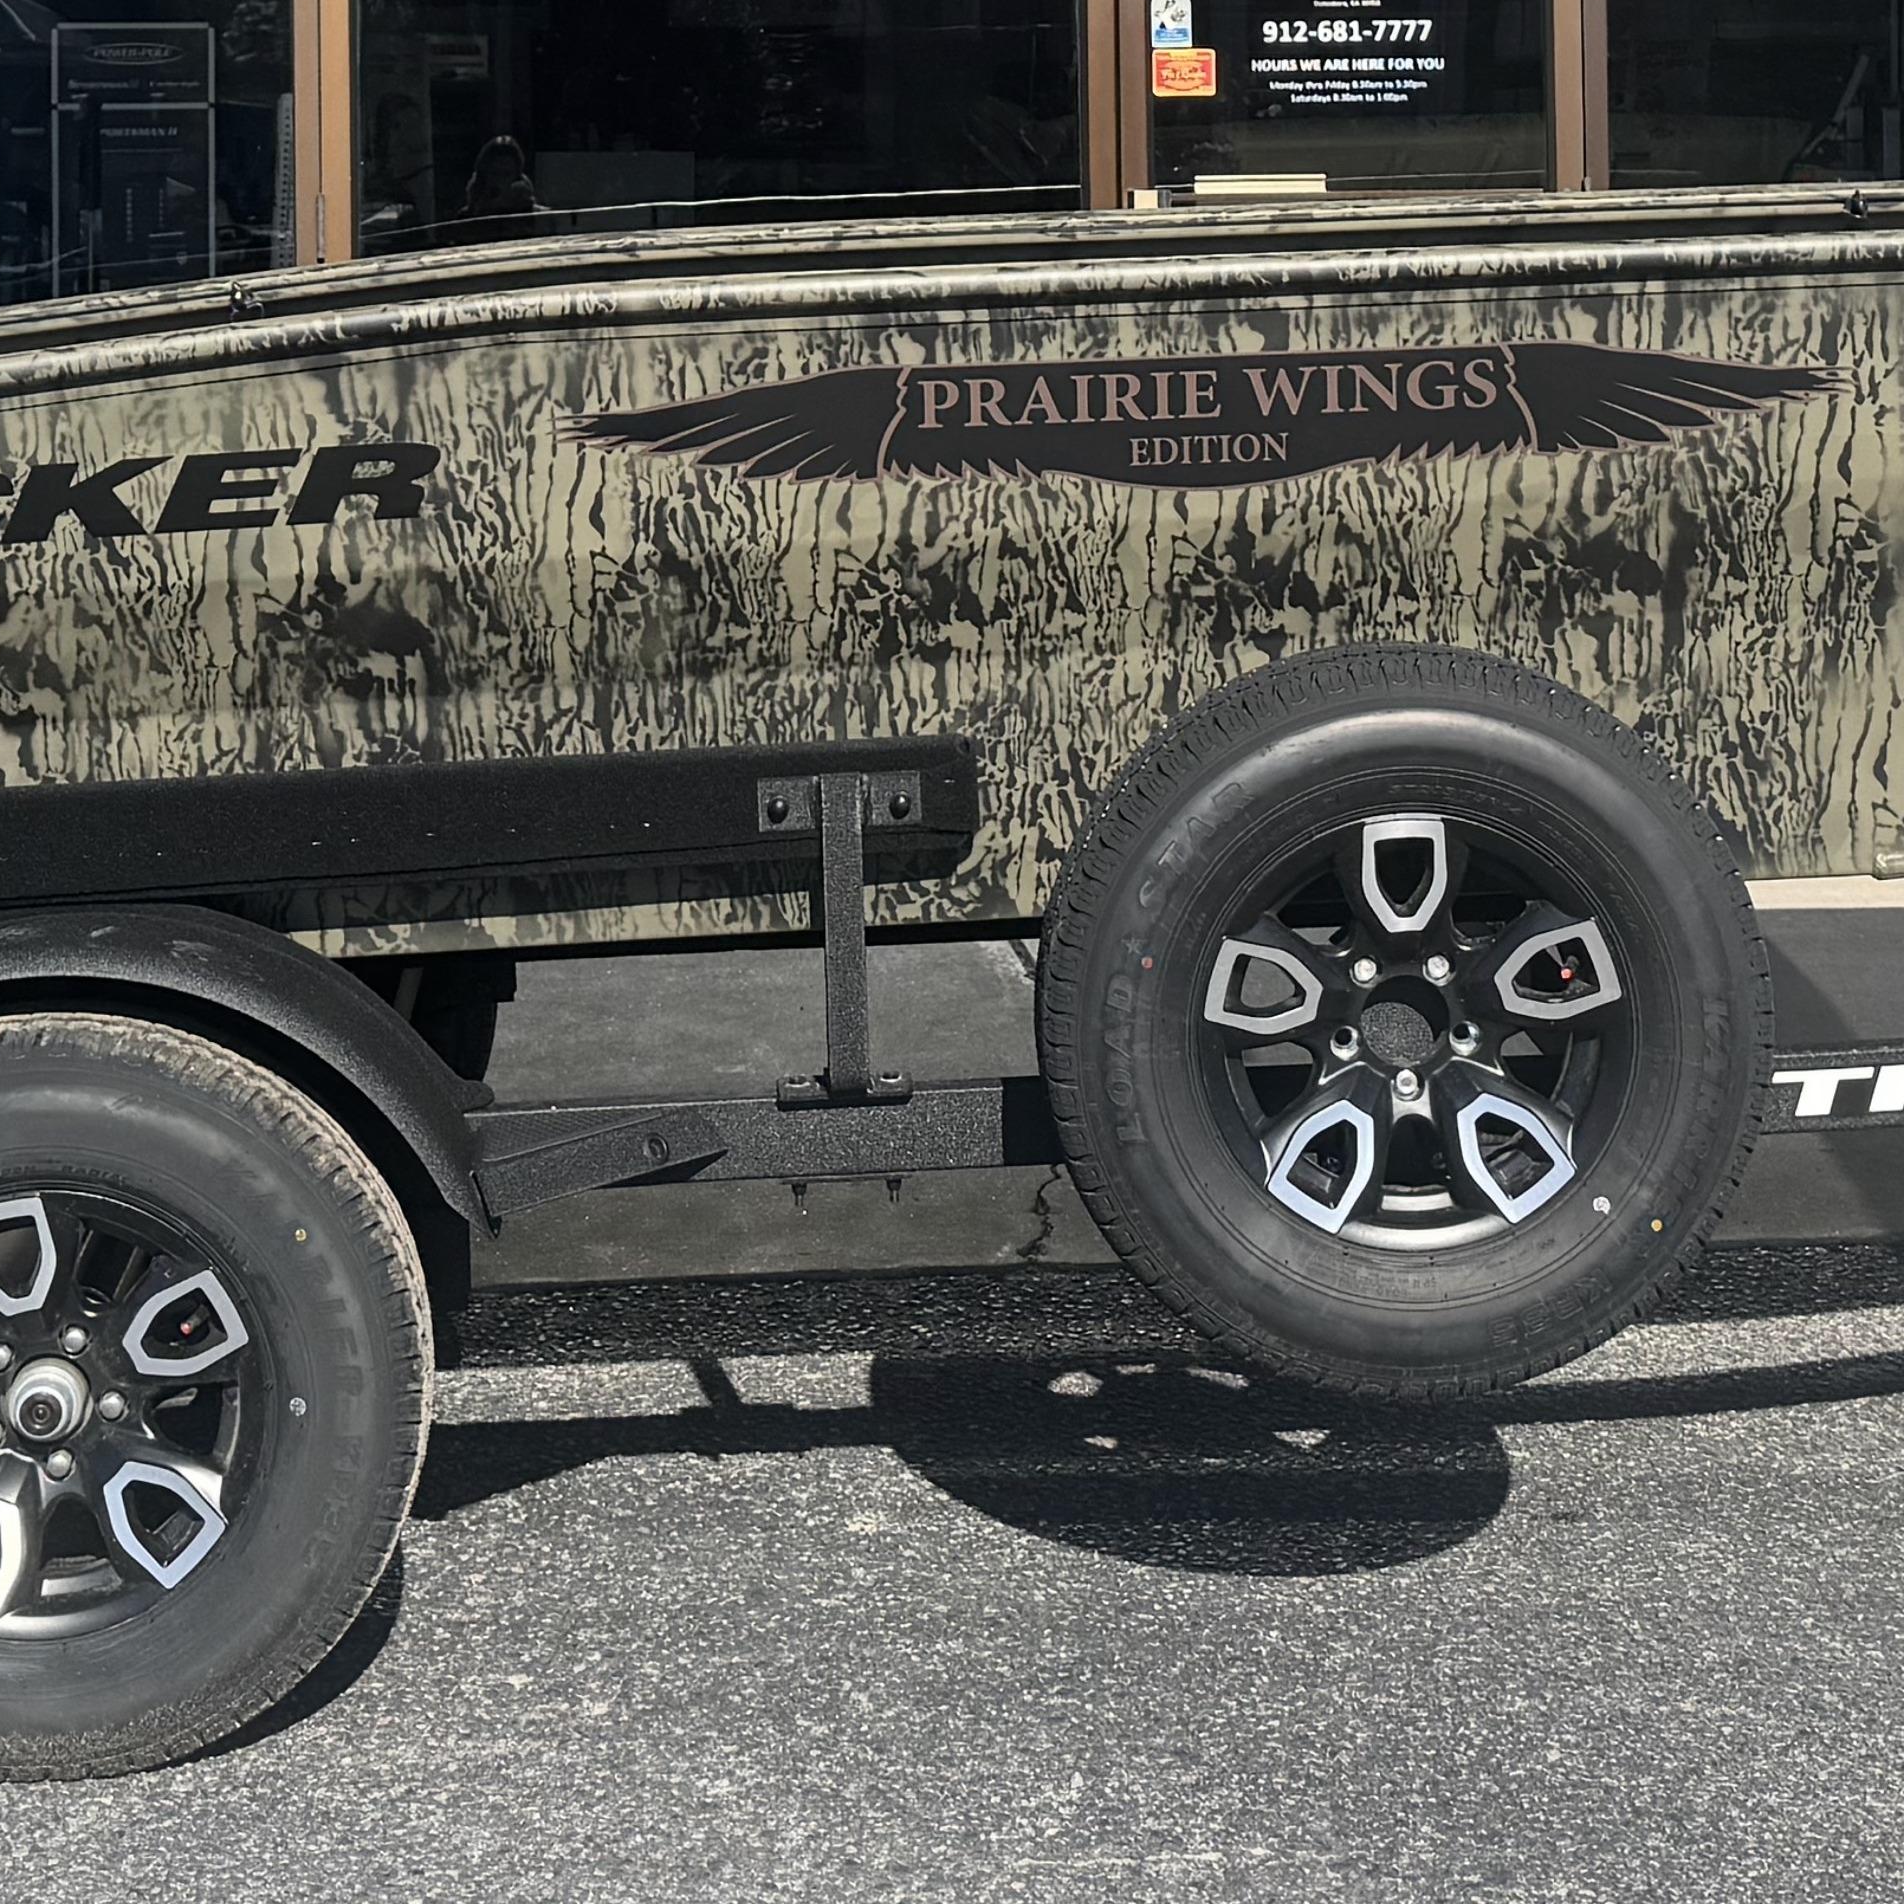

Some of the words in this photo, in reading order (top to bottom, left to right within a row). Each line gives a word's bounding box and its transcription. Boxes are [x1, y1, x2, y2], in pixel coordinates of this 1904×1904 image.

[1263, 19, 1433, 43] 912-681-7777
[1251, 59, 1298, 72] HOURS
[1300, 59, 1321, 71] WE
[1323, 59, 1350, 71] ARE
[1352, 59, 1386, 71] HERE
[1388, 58, 1414, 71] FOR
[1416, 58, 1445, 70] YOU
[917, 364, 1222, 432] PRAIRIE
[1241, 357, 1499, 417] WINGS
[1128, 432, 1291, 469] EDITION
[1104, 973, 1150, 1144] LOAD
[1138, 781, 1256, 916] STAR
